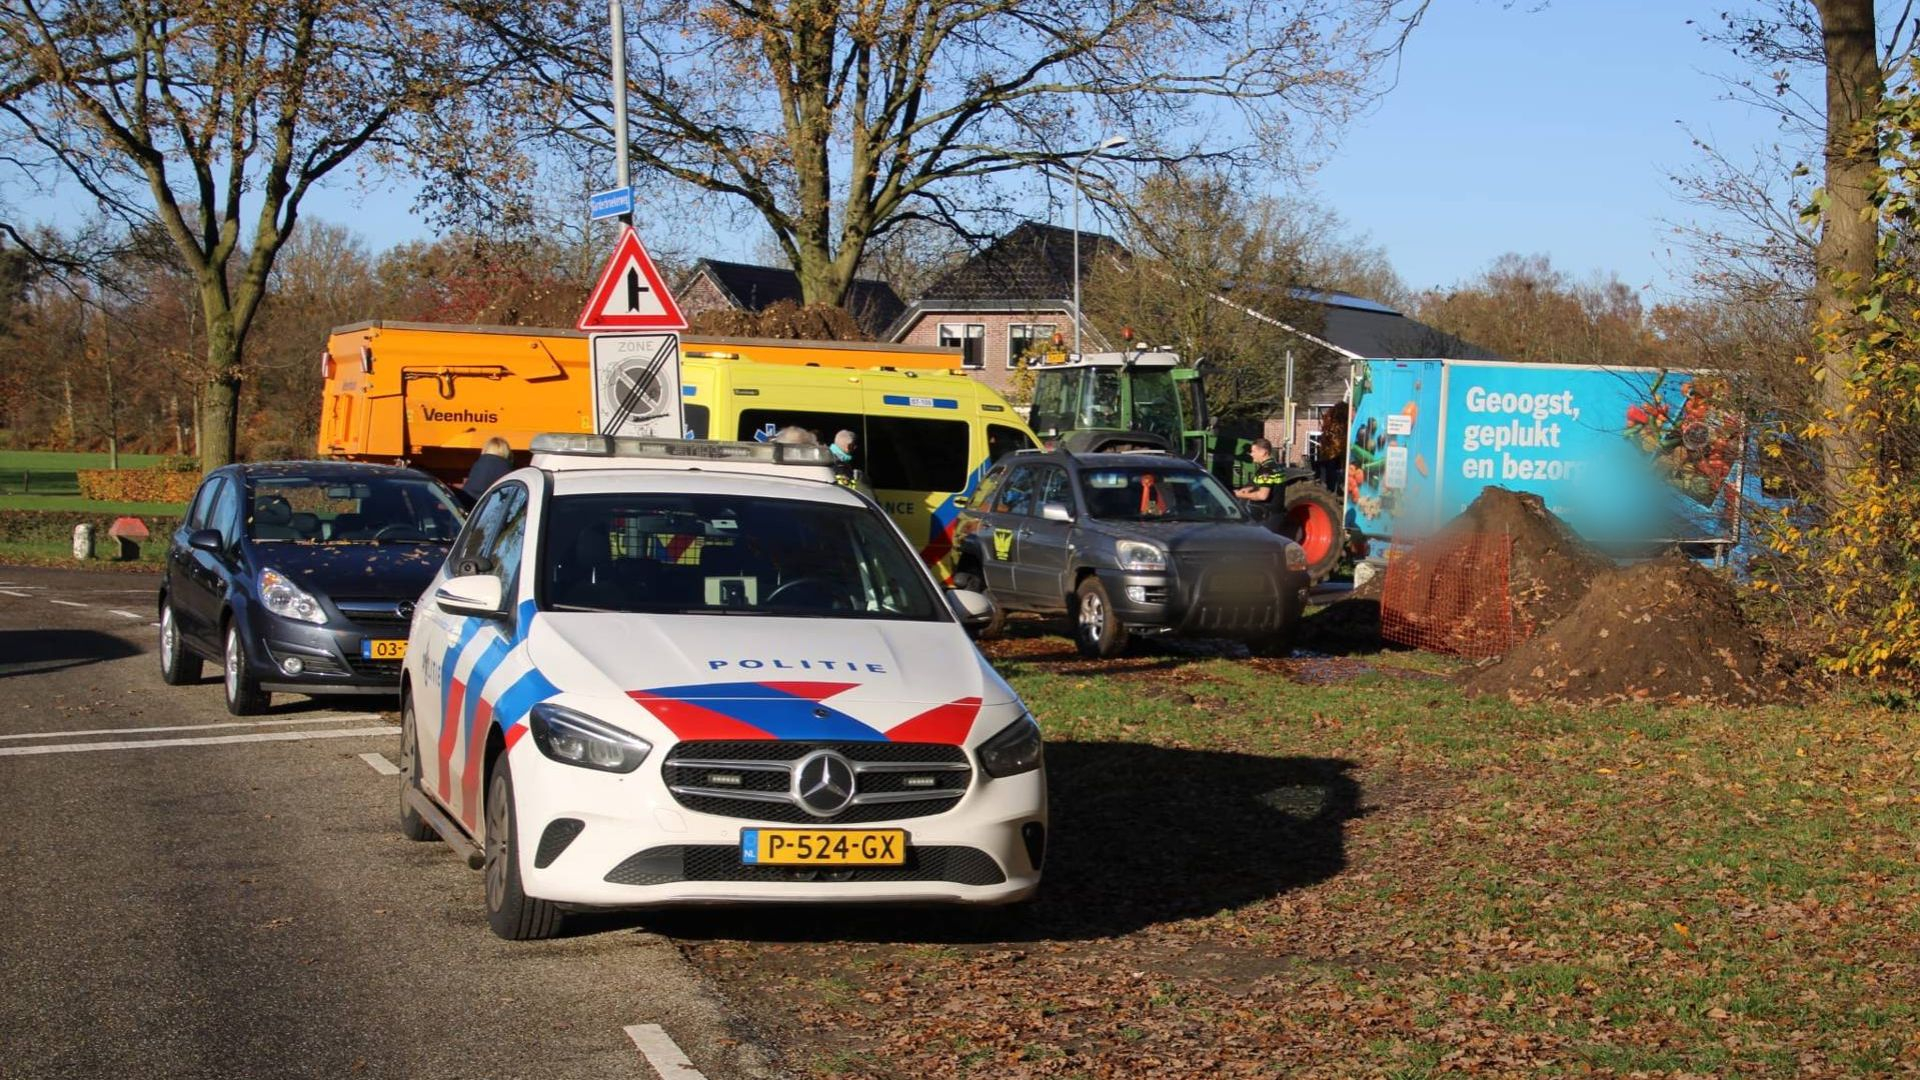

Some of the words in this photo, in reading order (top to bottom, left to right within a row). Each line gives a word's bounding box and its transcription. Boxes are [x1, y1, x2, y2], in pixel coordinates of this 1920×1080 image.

[618, 341, 655, 352] ZONE
[423, 407, 498, 423] Veenhuis
[1466, 386, 1580, 421] Geoogst,
[1463, 419, 1561, 452] geplukt
[1462, 457, 1494, 479] en
[1502, 452, 1583, 482] bezor
[708, 659, 887, 674] POLITIE
[743, 850, 756, 858] NL
[769, 834, 895, 859] P-524-GX
